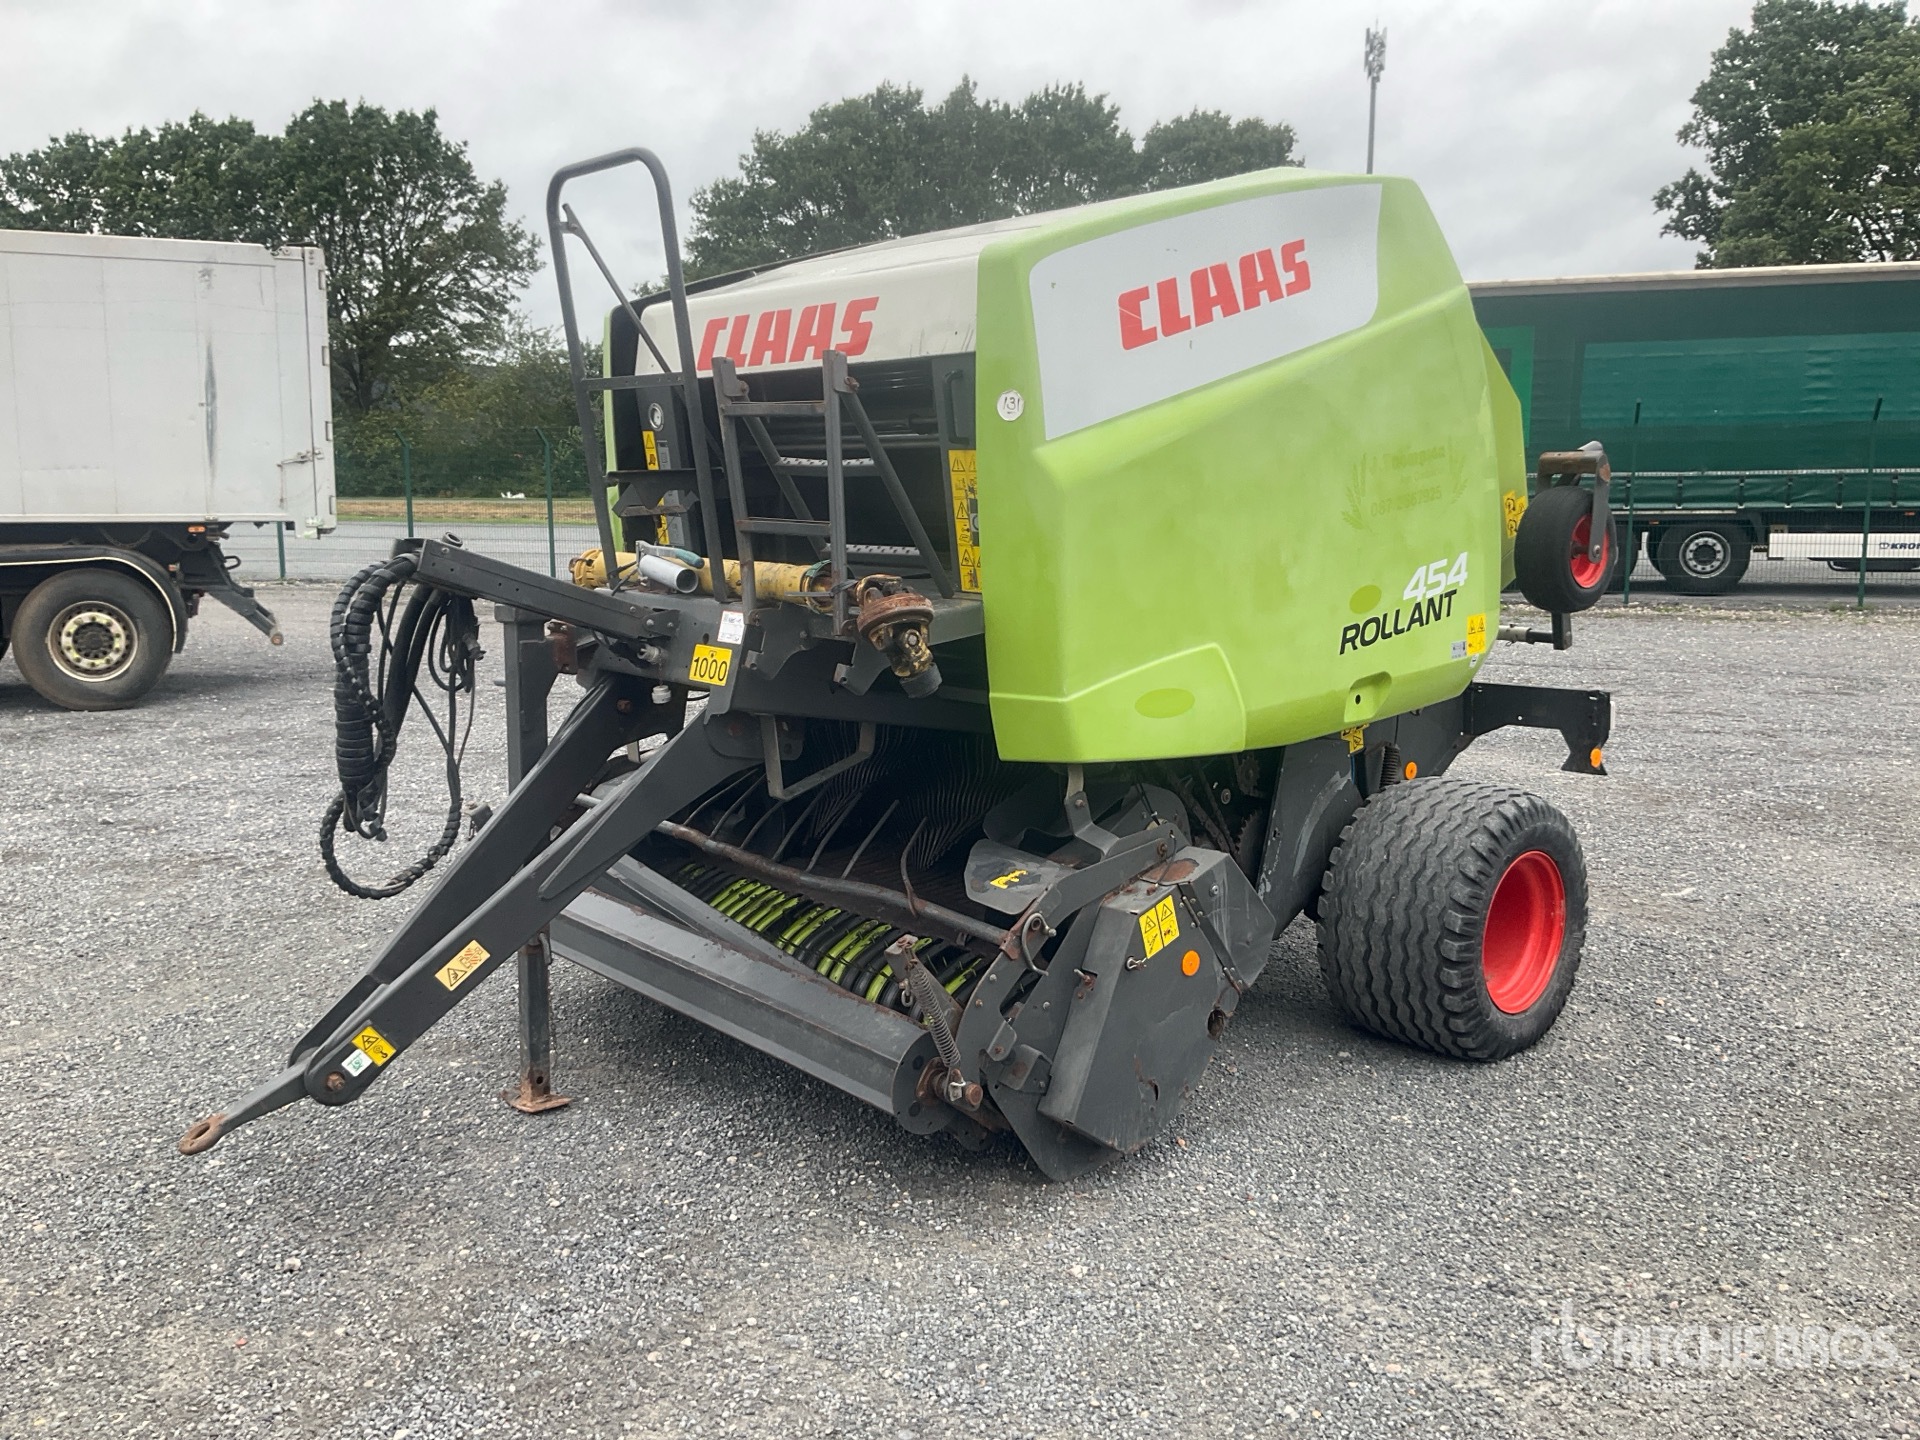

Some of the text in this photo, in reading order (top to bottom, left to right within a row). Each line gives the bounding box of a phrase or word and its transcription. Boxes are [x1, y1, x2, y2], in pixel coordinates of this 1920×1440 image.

[1117, 239, 1312, 350] CLAAS
[697, 296, 879, 370] CLAAS
[1403, 551, 1469, 604] 454
[1339, 589, 1458, 655] ROLLANT
[693, 656, 728, 682] 1000
